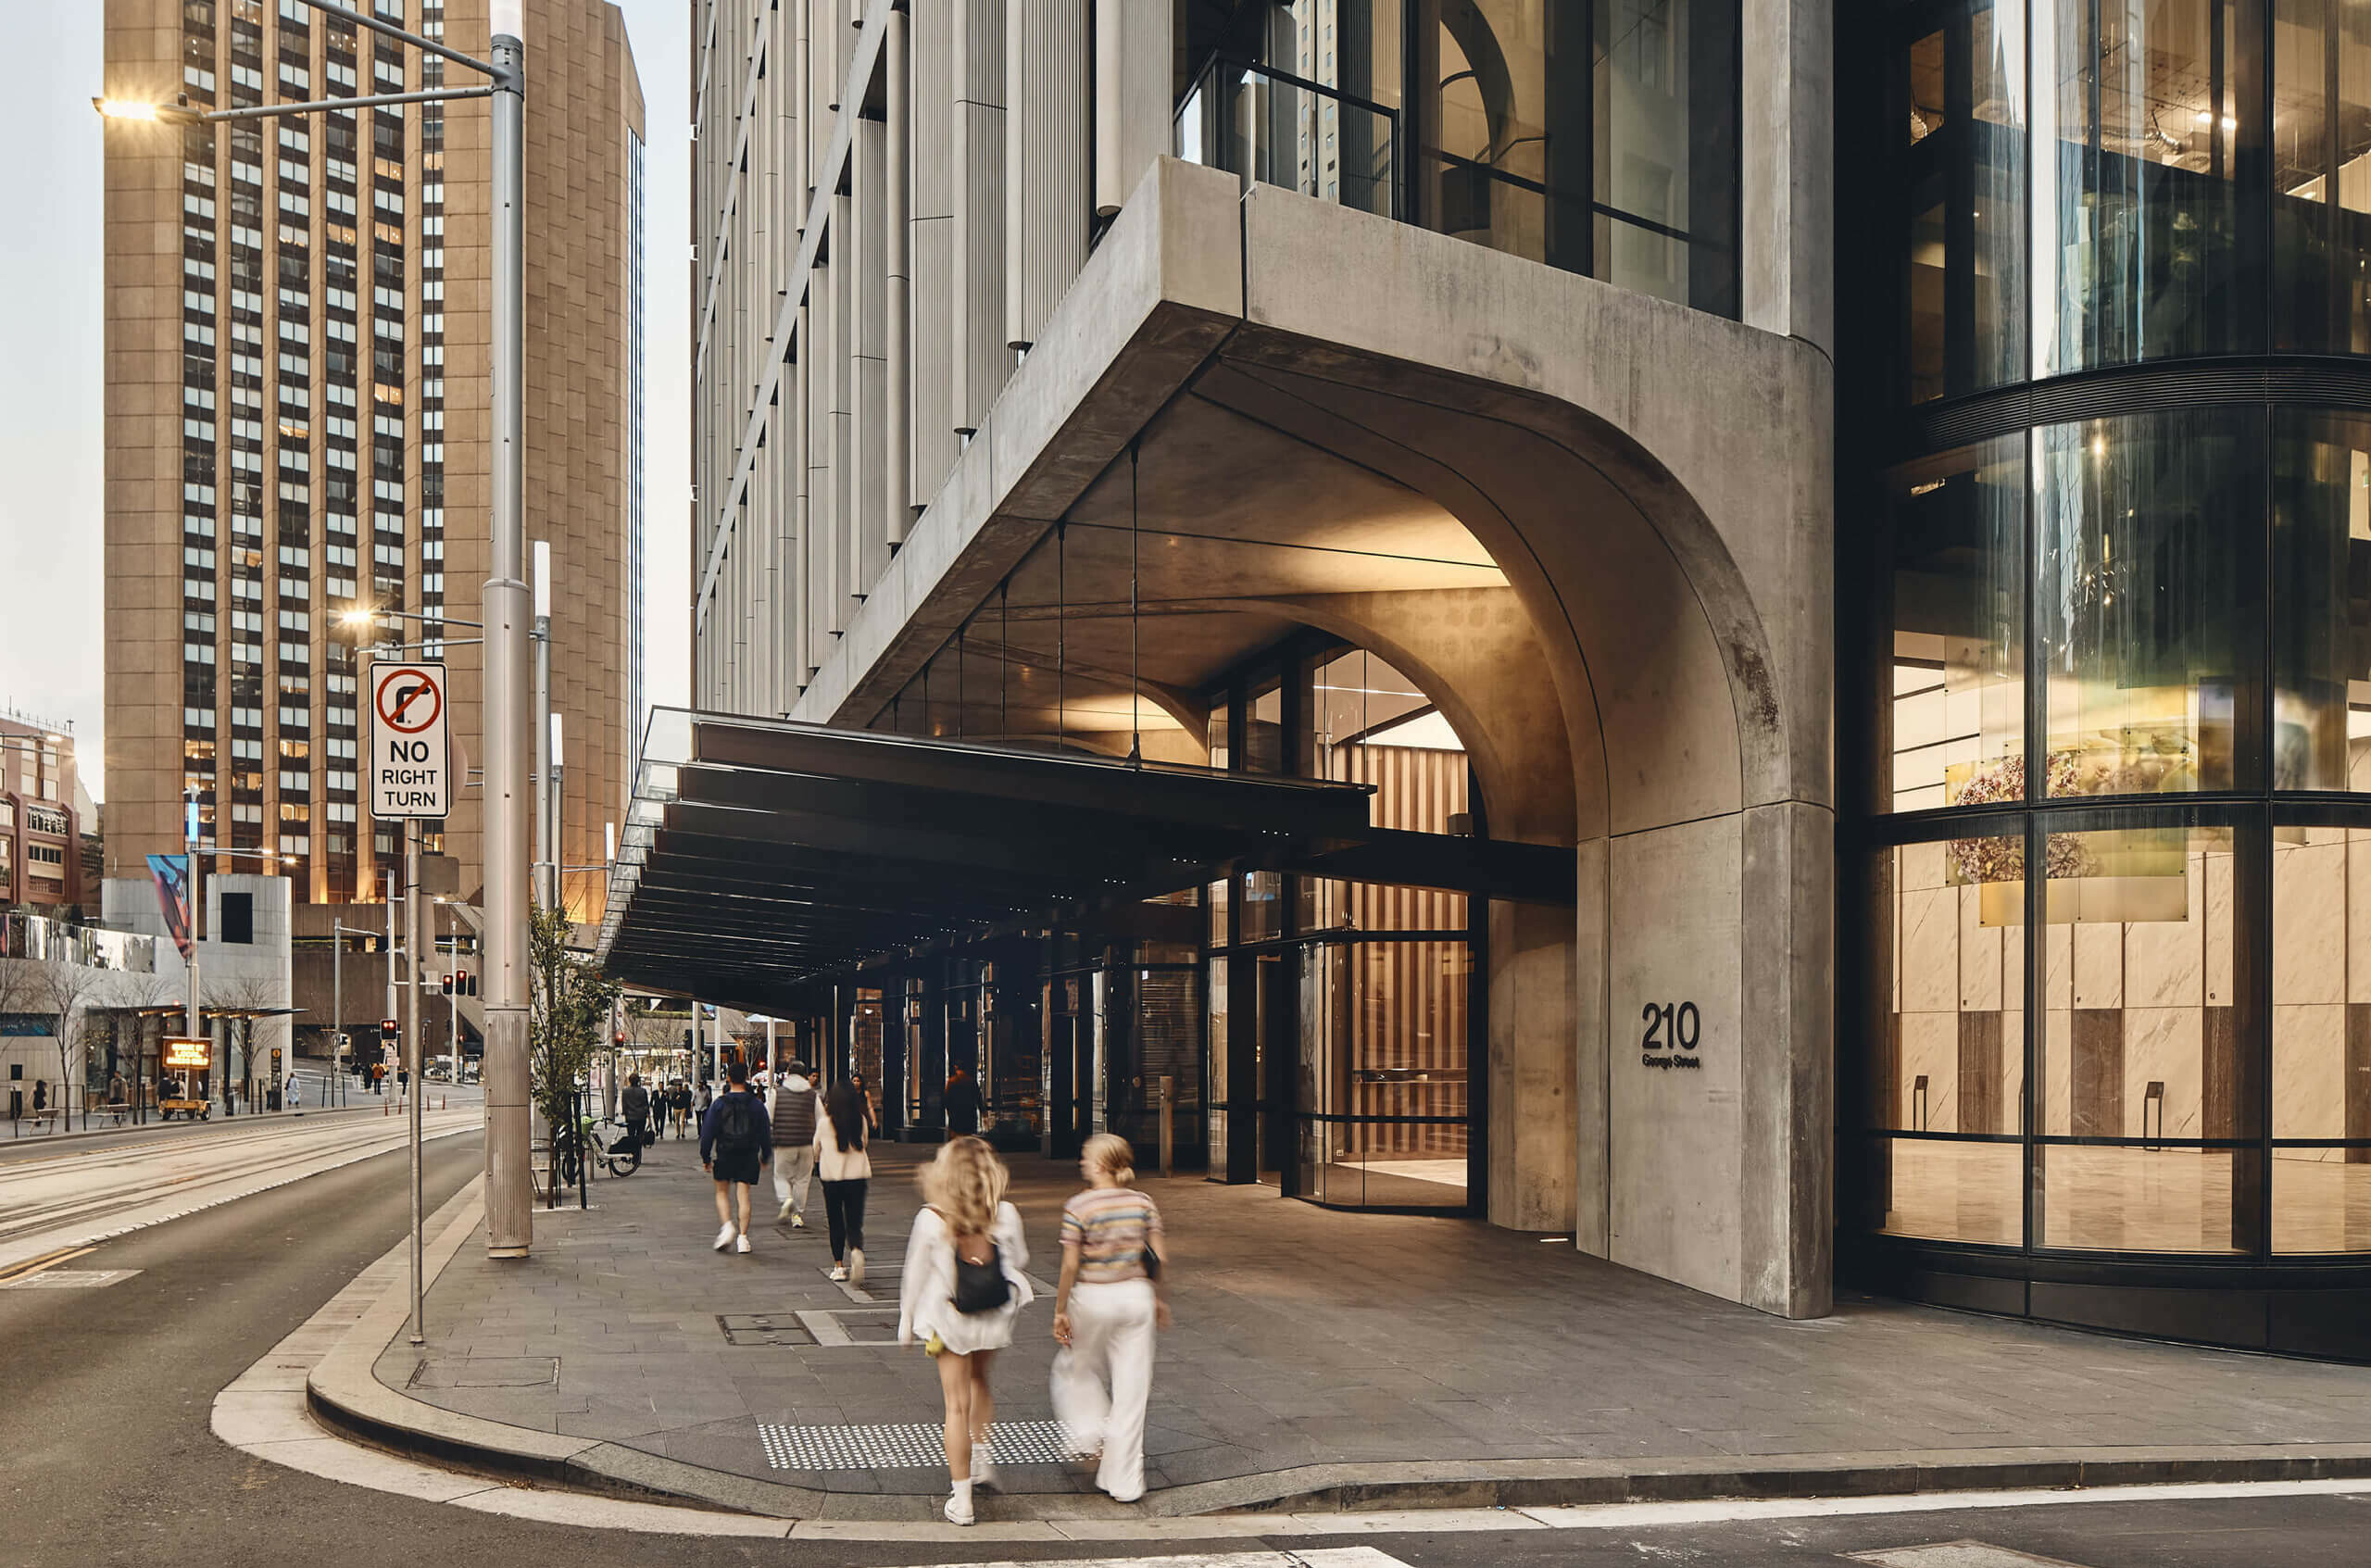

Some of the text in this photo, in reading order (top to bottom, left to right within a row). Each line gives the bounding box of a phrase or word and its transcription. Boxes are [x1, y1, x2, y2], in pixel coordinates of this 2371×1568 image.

[390, 741, 429, 762] NO
[382, 770, 437, 784] RIGHT
[384, 792, 436, 807] TURN
[1642, 1001, 1700, 1050] 210
